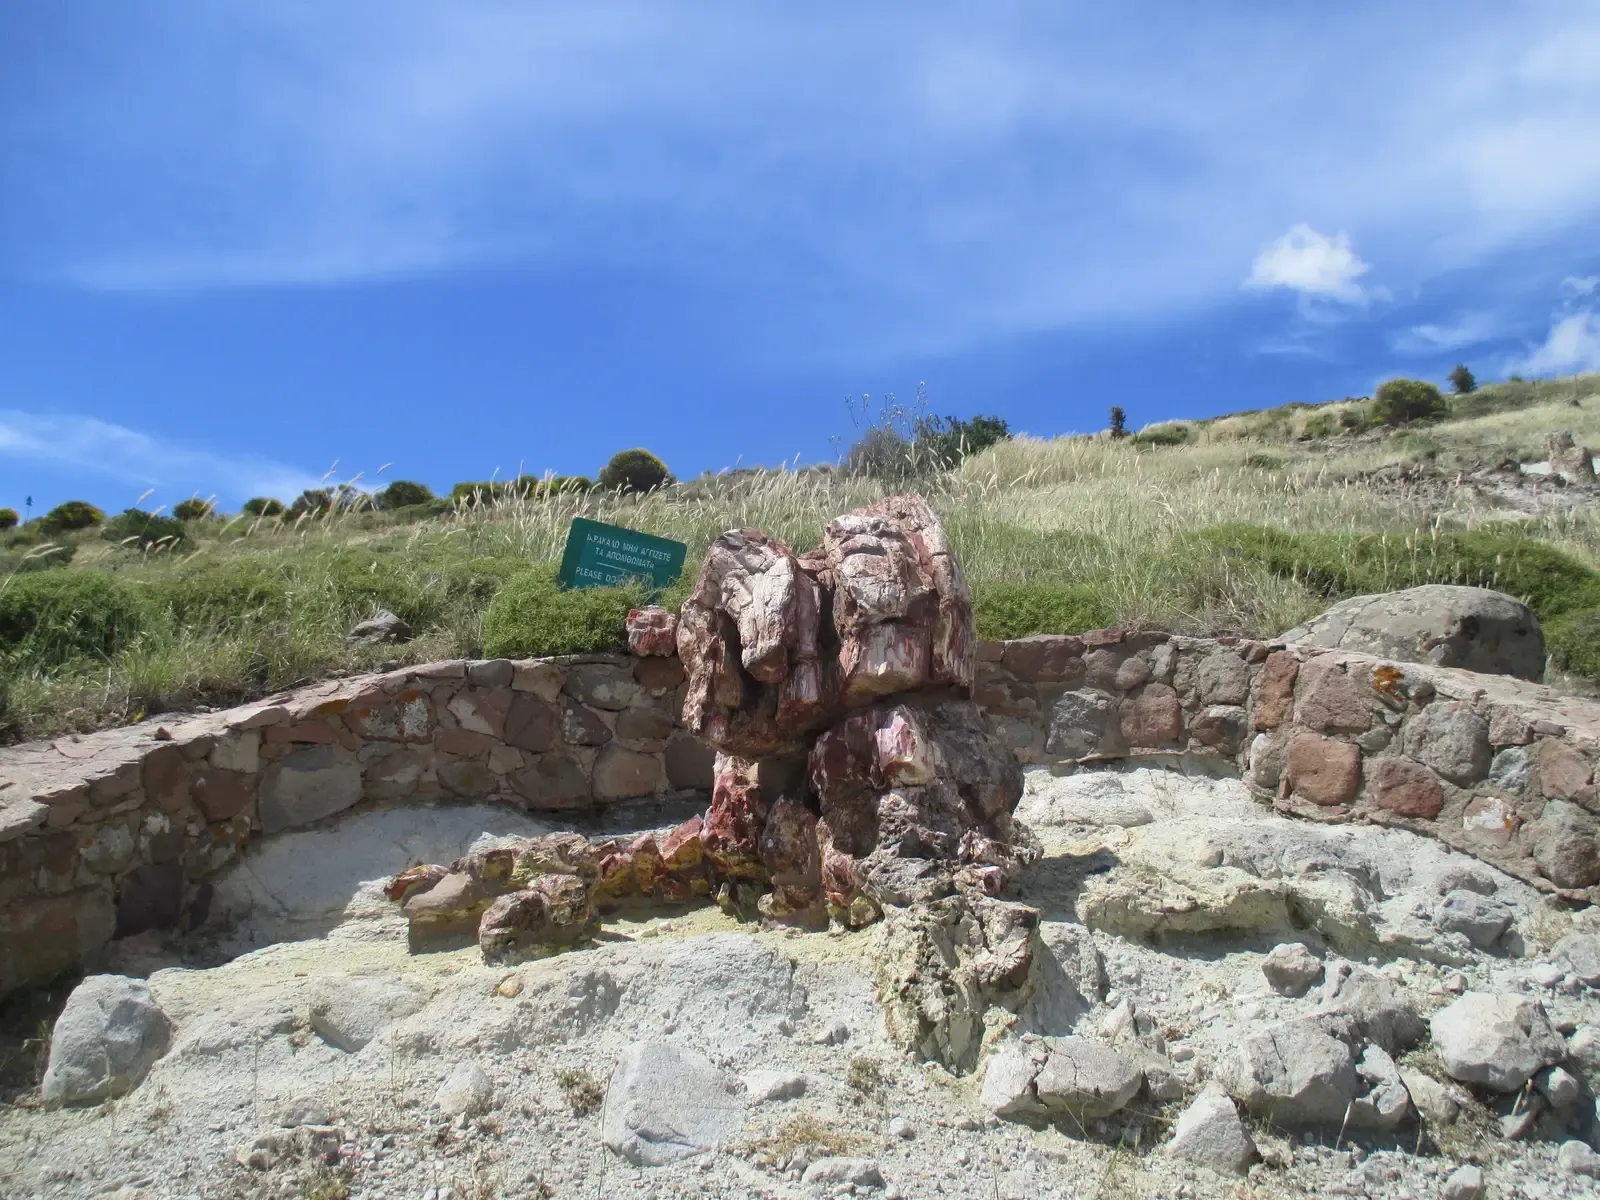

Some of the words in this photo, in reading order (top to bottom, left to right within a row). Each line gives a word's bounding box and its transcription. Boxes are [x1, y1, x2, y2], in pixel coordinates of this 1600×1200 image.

[587, 534, 620, 548] ΠΡΑΚΑΛΩ
[596, 547, 604, 556] ΤΑ
[576, 566, 602, 580] PLEASE
[606, 574, 616, 584] DO
